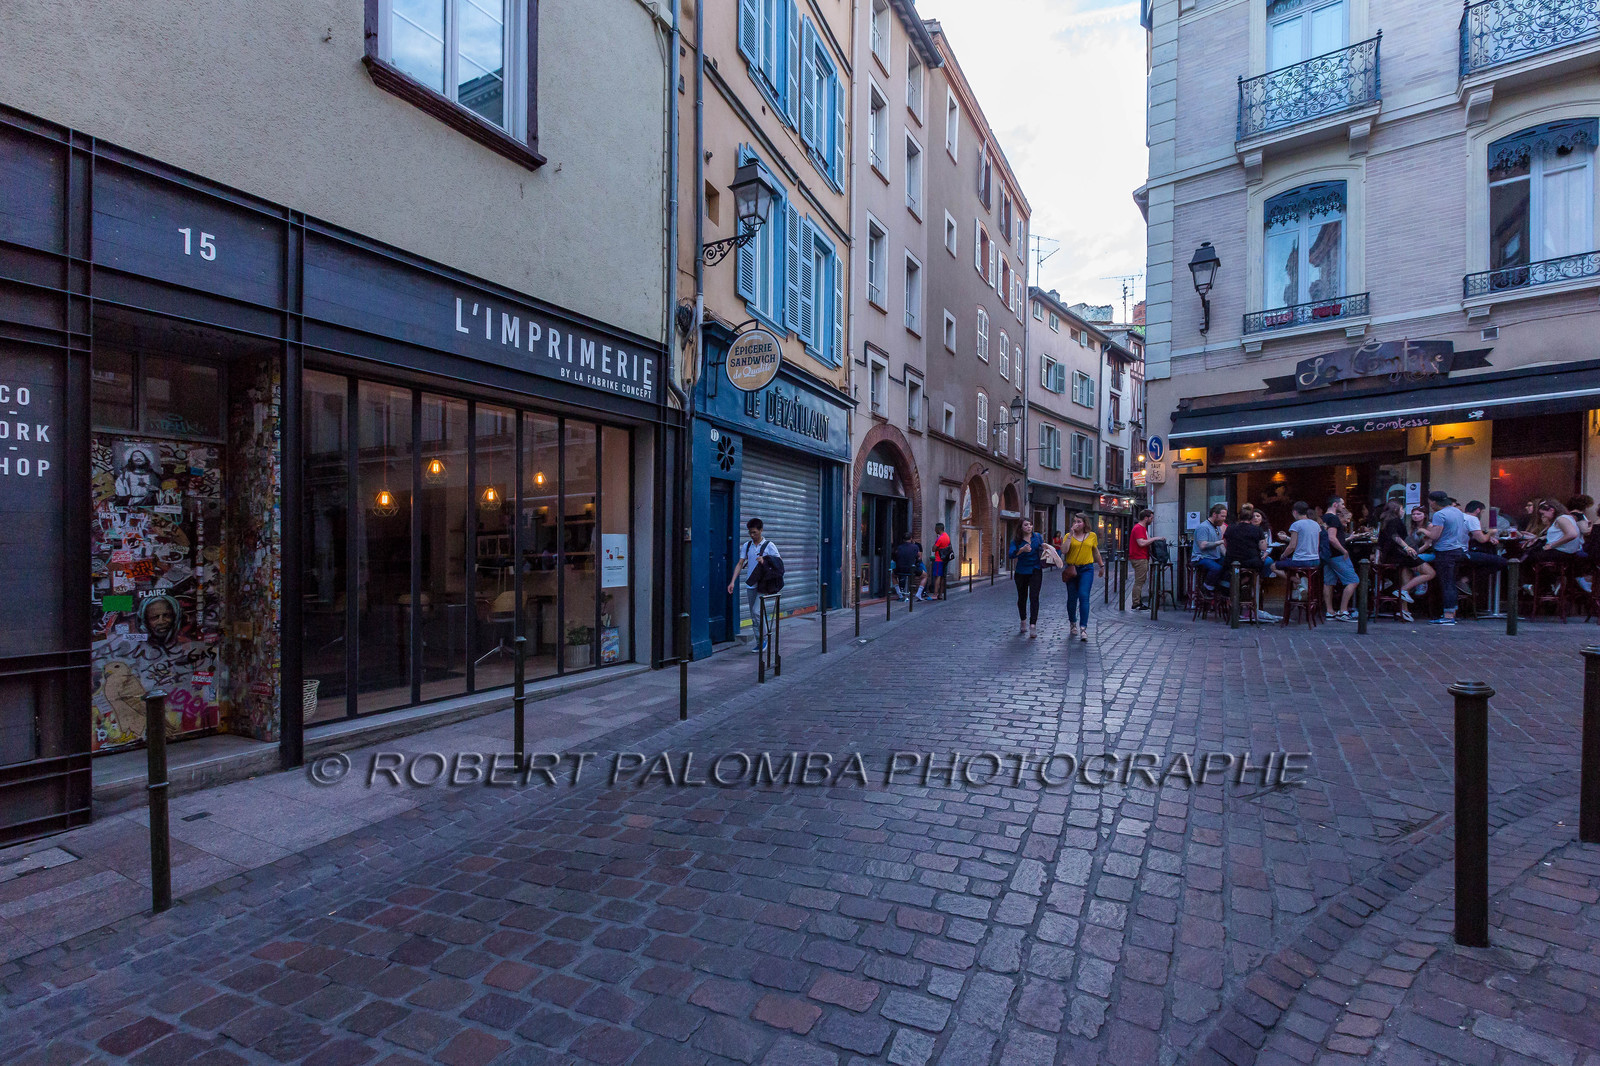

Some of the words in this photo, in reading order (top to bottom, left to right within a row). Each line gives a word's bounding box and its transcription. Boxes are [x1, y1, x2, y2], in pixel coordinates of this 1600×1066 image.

[178, 227, 217, 261] 15
[455, 297, 653, 389] L'IMPRIMERIE
[734, 343, 773, 356] ÉPICERIE
[730, 354, 776, 368] SANDWICH
[560, 367, 570, 378] BY
[574, 371, 584, 382] LA
[587, 375, 618, 391] FABRIKE
[621, 383, 652, 400] CONCEPT
[732, 369, 742, 380] de
[0, 421, 50, 443] ORK
[1325, 423, 1360, 436] La
[1363, 417, 1431, 432] Comtesse
[0, 457, 50, 477] HOP
[866, 460, 895, 481] GHOST
[138, 588, 167, 599] FLAIR2
